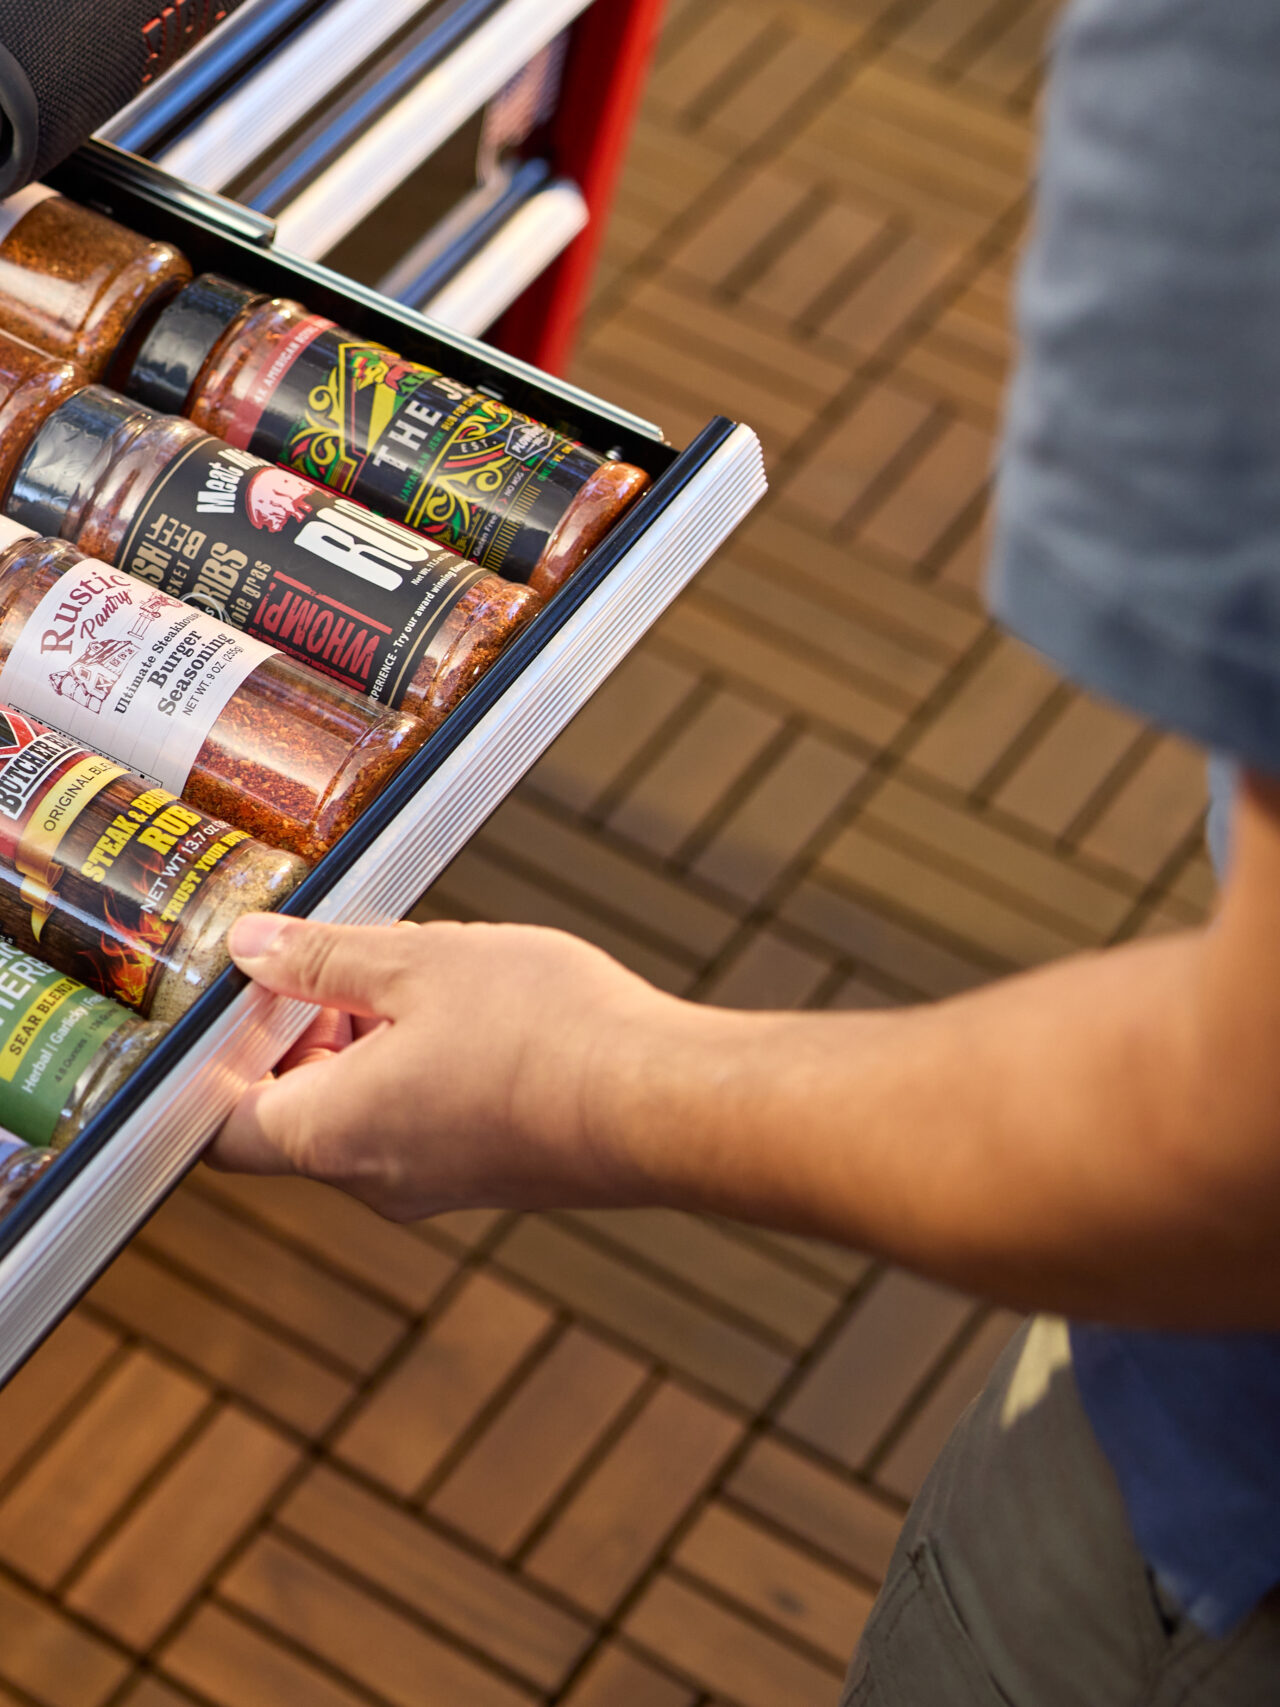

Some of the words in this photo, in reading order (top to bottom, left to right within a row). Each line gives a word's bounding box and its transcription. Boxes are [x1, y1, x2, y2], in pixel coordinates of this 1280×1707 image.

[263, 342, 301, 388] AMERICAN
[372, 400, 443, 472] THE
[400, 452, 431, 502] JAMAICAN
[428, 431, 446, 452] JERK
[440, 415, 458, 431] RUB
[452, 403, 469, 417] FOR
[460, 439, 497, 453] EST.
[196, 461, 245, 514] Meat
[473, 531, 489, 557] Gluten
[484, 514, 499, 533] Free
[504, 484, 515, 497] NO
[513, 472, 525, 487] MSG
[145, 513, 207, 560] BEEF
[192, 542, 248, 610] RIBS
[241, 560, 272, 598] gras
[393, 632, 410, 649] Try
[404, 616, 419, 633] our
[414, 591, 435, 617] award
[431, 568, 458, 594] winning
[411, 573, 423, 586] Net
[40, 571, 132, 655] Rustic
[80, 589, 134, 640] Pantry
[254, 582, 380, 680] WHOMP!
[114, 655, 156, 715] Ultimate
[152, 612, 201, 654] Steakhouse
[147, 630, 202, 689] Burger
[157, 633, 236, 716] Seasoning
[182, 695, 201, 716] NET
[195, 680, 212, 696] WT.
[211, 661, 226, 674] OZ.
[44, 774, 95, 832] ORIGINAL
[137, 805, 202, 856] RUB
[81, 814, 140, 883] STEAK
[128, 811, 148, 823] &
[140, 877, 169, 914] NET
[162, 853, 187, 878] WT
[181, 831, 207, 855] 13.7
[203, 821, 220, 836] OZ
[161, 870, 203, 922] TRUST
[194, 841, 230, 872] YOUR
[9, 1014, 42, 1056] SEAR
[37, 983, 73, 1014] BLEND
[21, 1048, 53, 1094] Herbal
[49, 1005, 88, 1044] Garlicky
